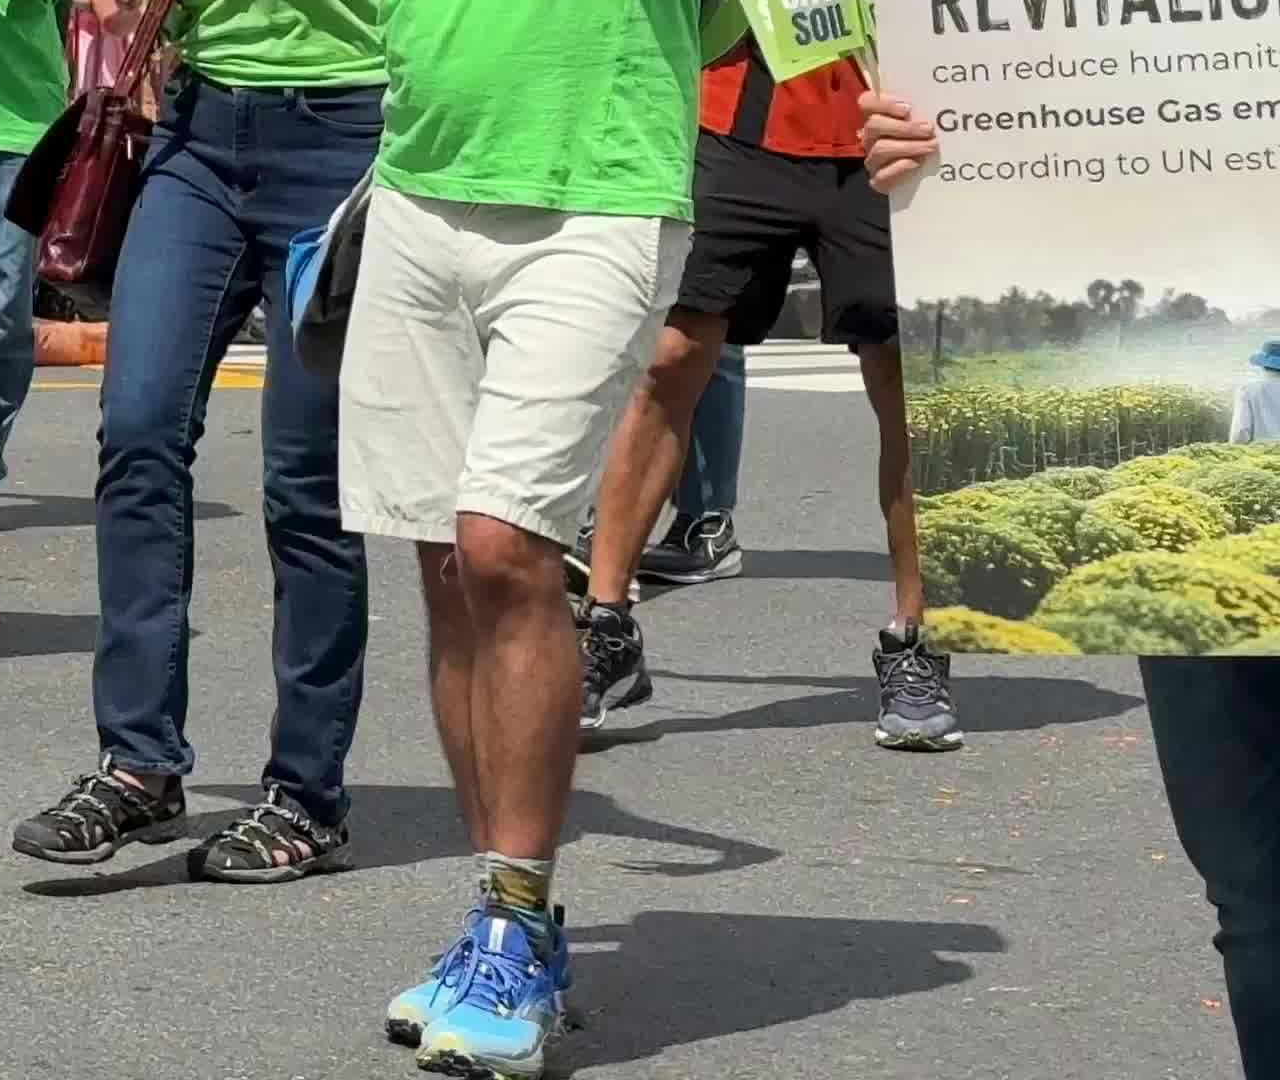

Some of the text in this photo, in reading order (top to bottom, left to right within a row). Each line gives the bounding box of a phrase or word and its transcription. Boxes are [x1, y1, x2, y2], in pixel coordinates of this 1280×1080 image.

[791, 3, 852, 46] SOIL
[932, 42, 1280, 84] can reduce humanit
[936, 103, 1146, 133] Greenhouse
[1157, 98, 1223, 124] Gas
[939, 146, 1280, 183] according to UN est
